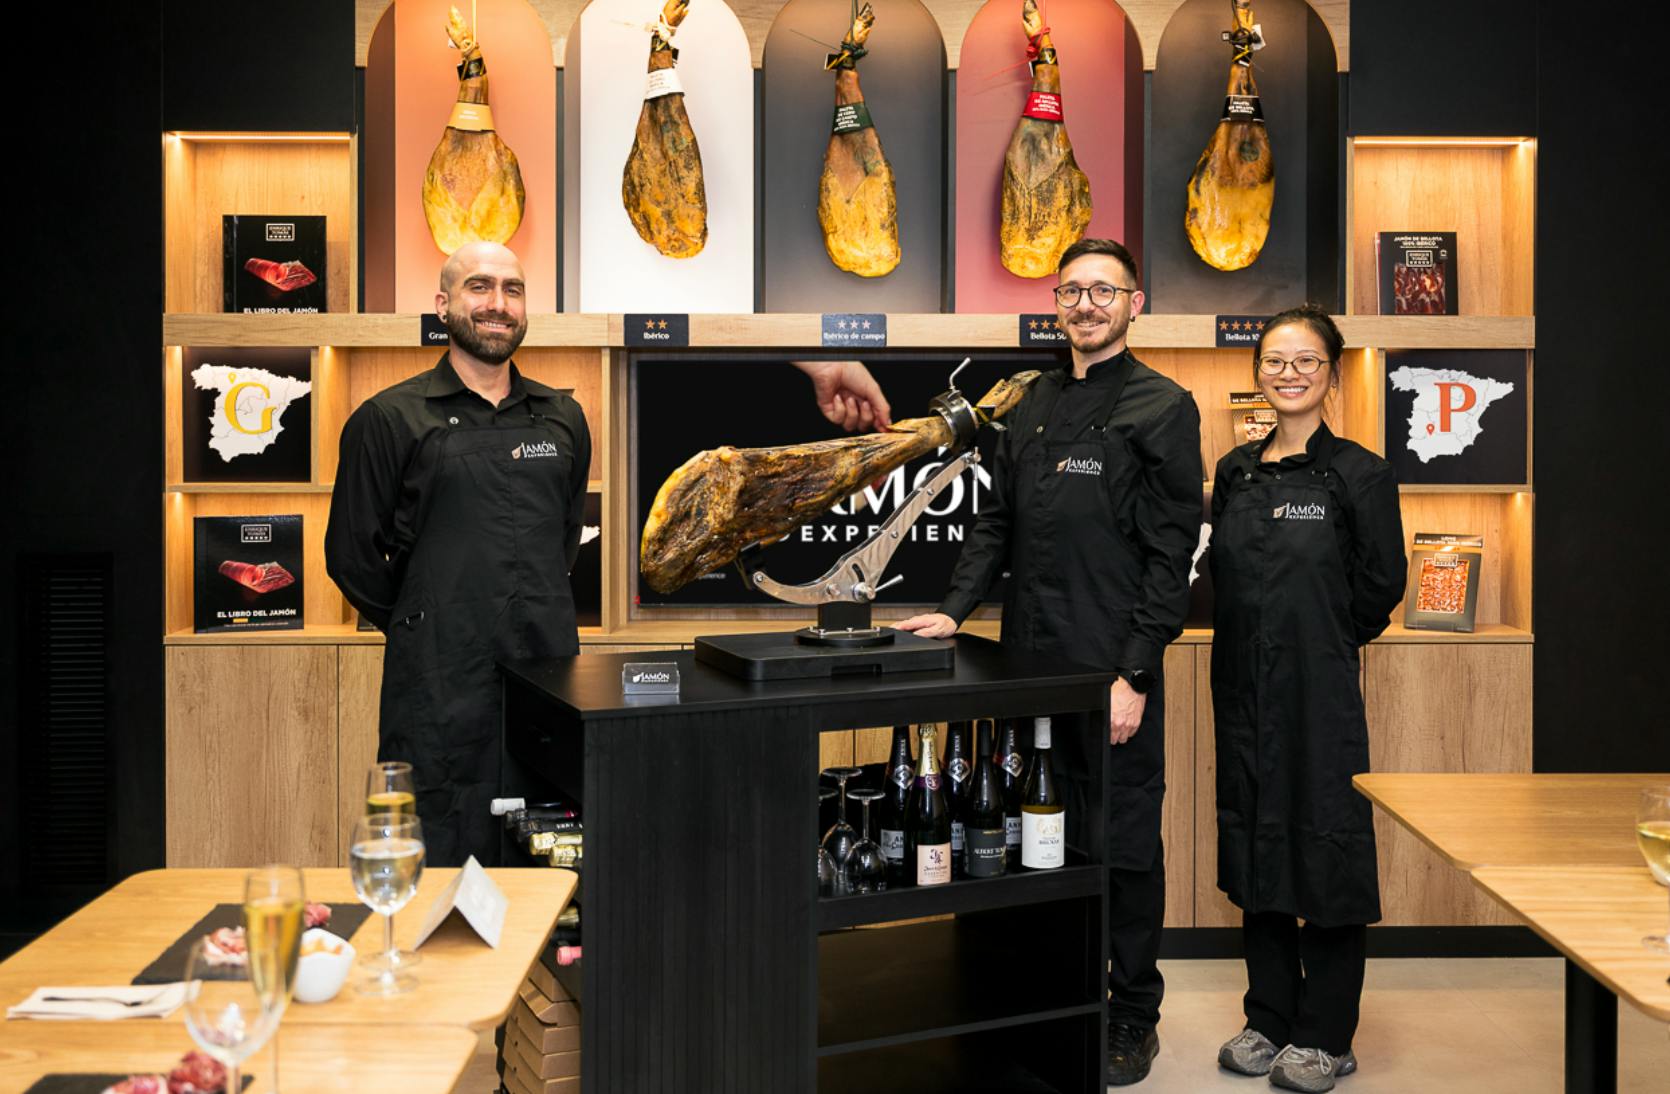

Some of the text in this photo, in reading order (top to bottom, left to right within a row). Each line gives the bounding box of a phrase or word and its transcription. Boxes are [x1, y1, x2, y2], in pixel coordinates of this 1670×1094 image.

[292, 306, 318, 314] JAMÓN
[428, 331, 448, 340] Gran
[643, 331, 670, 340] Ibérico
[823, 331, 886, 342] Ibérico de campo
[1030, 332, 1056, 340] Bellota
[1225, 332, 1251, 341] Bellota
[224, 382, 277, 435] G
[1434, 382, 1476, 432] P
[520, 440, 558, 458] JAMÓN
[1064, 456, 1102, 472] JAMÓN
[1285, 502, 1325, 518] JAMÓN
[801, 525, 964, 542] EXPEIEN
[228, 610, 252, 618] LIBRO
[268, 608, 296, 616] JAMÓN
[640, 672, 670, 682] JAMÓN
